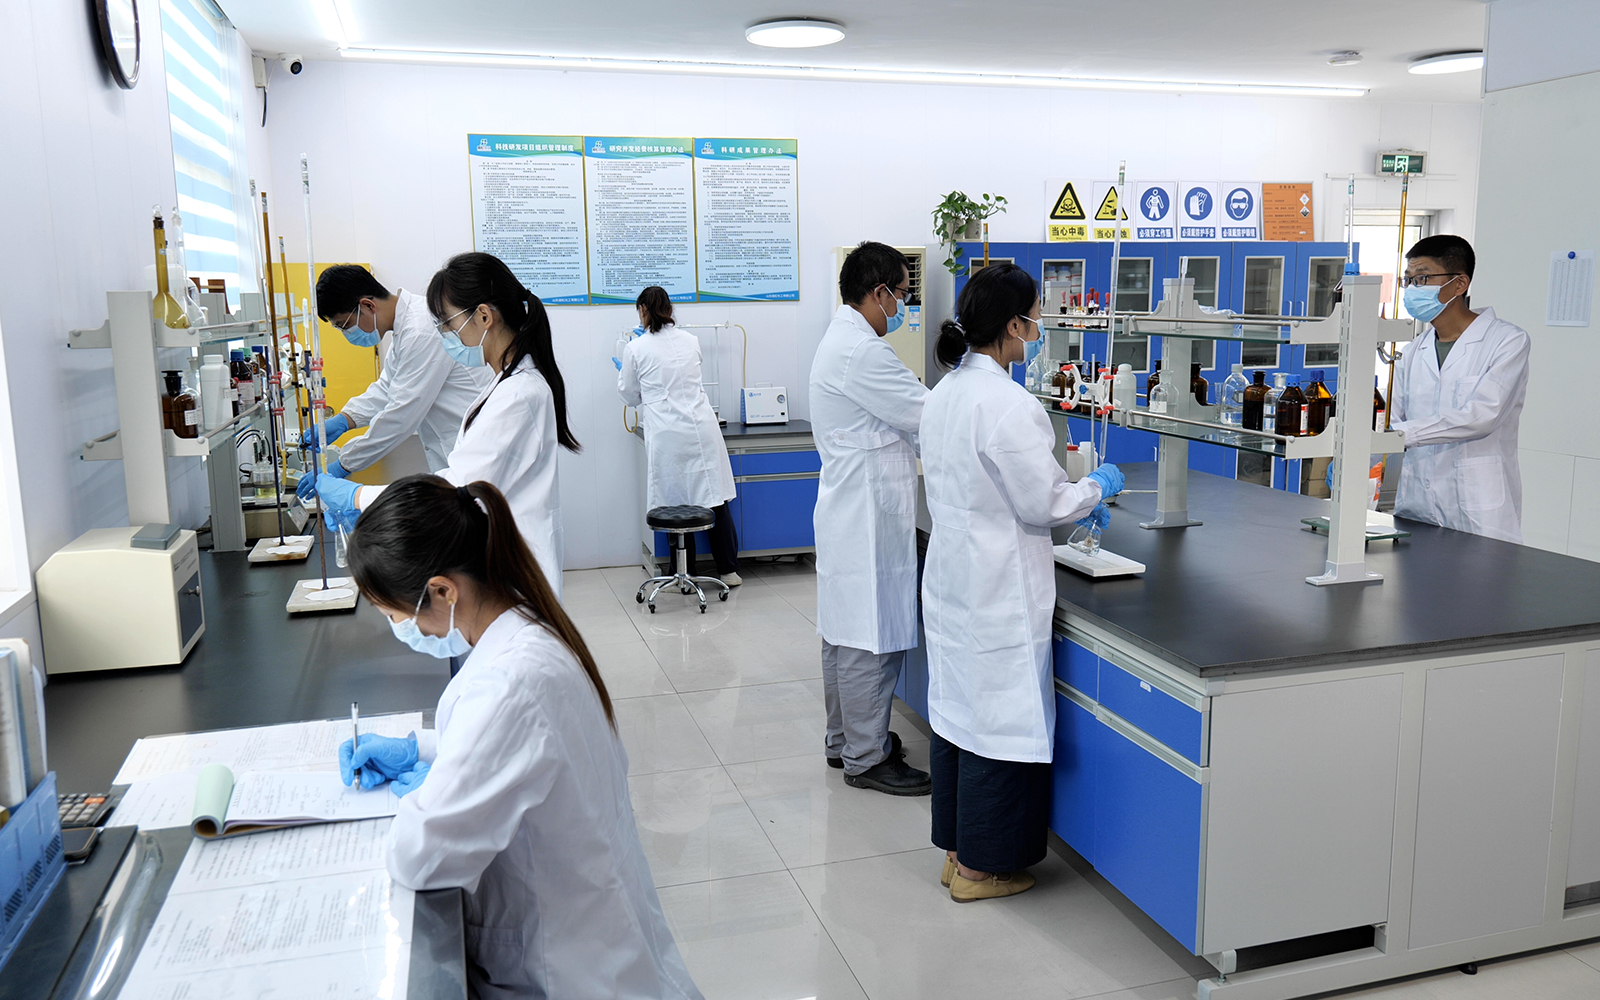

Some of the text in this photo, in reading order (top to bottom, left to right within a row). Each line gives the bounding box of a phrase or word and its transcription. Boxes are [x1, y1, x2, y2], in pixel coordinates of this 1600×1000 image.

[495, 143, 574, 152] 科技研发项目组织管理制度
[721, 146, 782, 154] 科研成果管理办法
[1052, 226, 1084, 236] 当心中毒
[1139, 228, 1171, 238] 必须穿工作服
[1182, 228, 1214, 237] 必须戴防护手套
